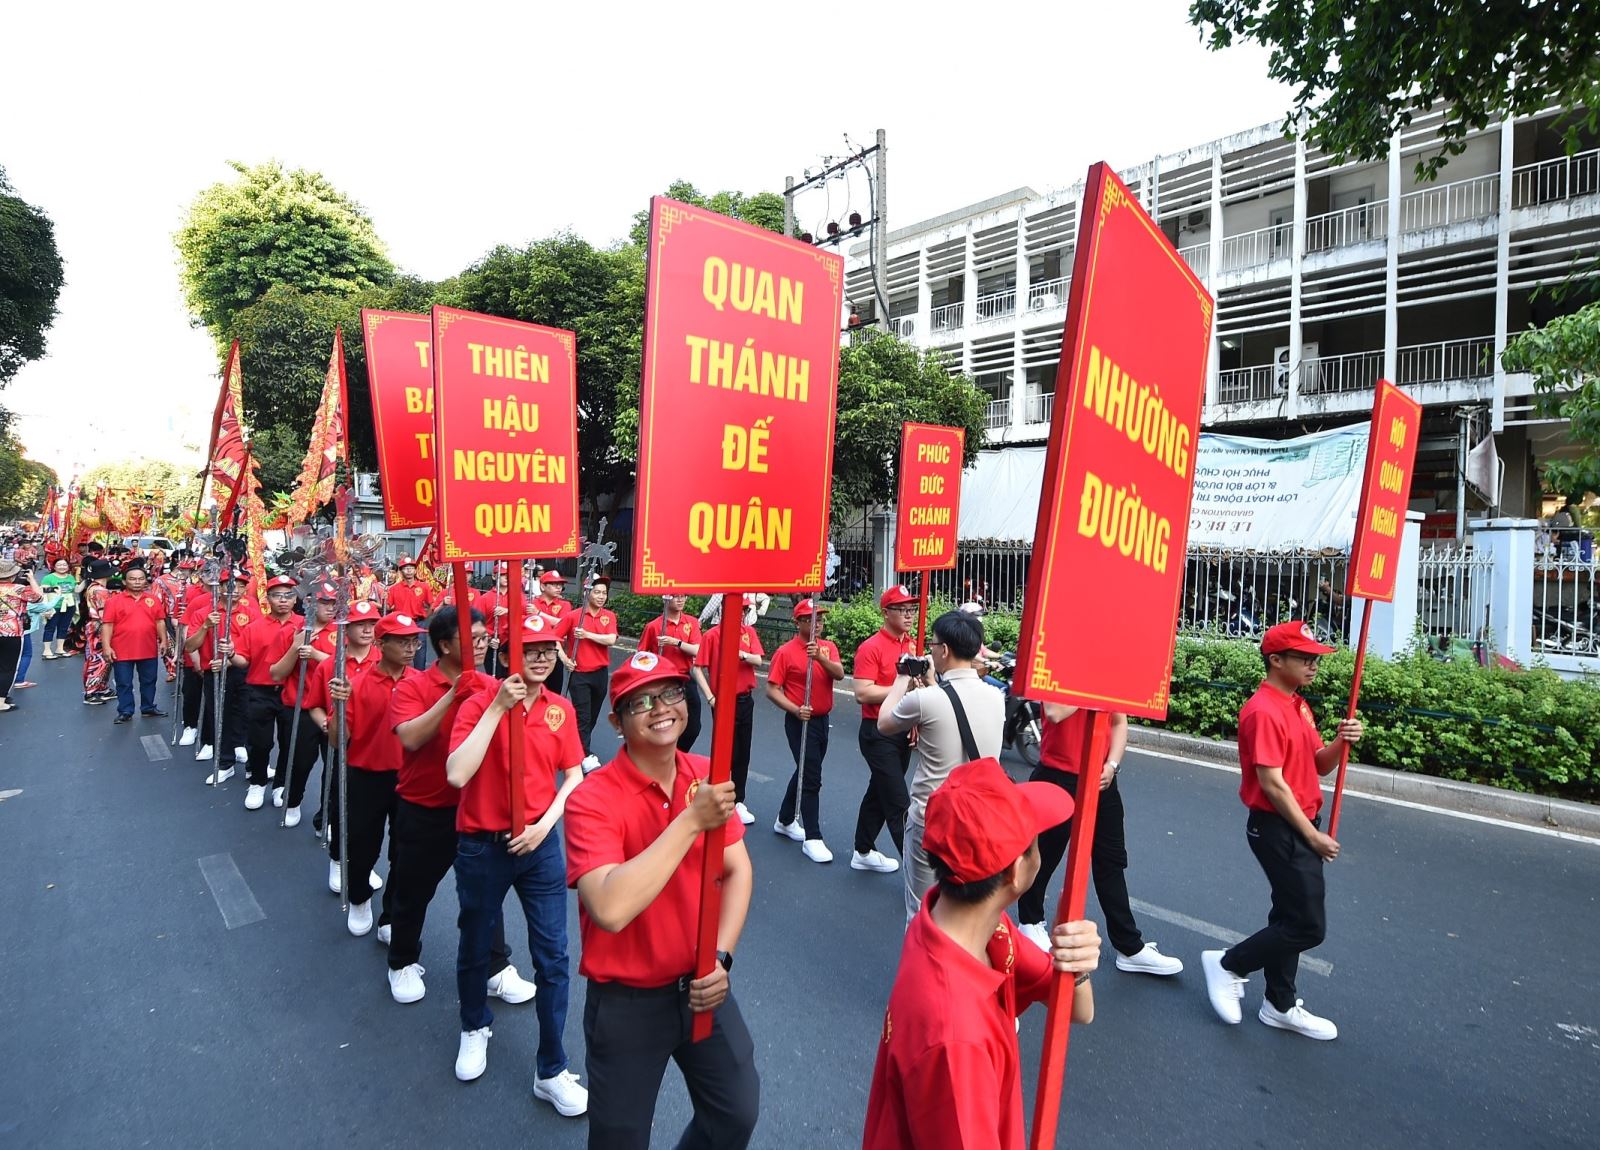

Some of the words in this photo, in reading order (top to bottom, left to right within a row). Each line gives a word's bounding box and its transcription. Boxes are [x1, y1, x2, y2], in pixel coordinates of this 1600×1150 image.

[702, 256, 804, 325] QUAN
[467, 343, 550, 384] THIÊN
[685, 335, 811, 403] THÁNH
[483, 394, 539, 438] HẬU
[1083, 344, 1190, 479] NHƯỜNG
[721, 415, 775, 474] ĐẾ
[1389, 416, 1407, 453] HỘI
[453, 448, 566, 484] NGUYÊN
[917, 441, 951, 465] PHÚC
[919, 472, 945, 495] ĐỨC
[1243, 467, 1271, 477] PHỤC
[1245, 482, 1266, 492] LỚP
[1268, 481, 1277, 490] &
[1379, 460, 1405, 496] QUÁN
[909, 503, 951, 526] CHÁNH
[1201, 508, 1254, 517] GRADUATION
[1213, 493, 1243, 504] ĐỘNG
[1245, 493, 1275, 503] HOẠT
[1277, 493, 1298, 503] LỚP
[475, 498, 551, 538] QUÂN
[688, 496, 792, 554] QUÂN
[1077, 470, 1171, 574] ĐƯỜNG
[1369, 552, 1386, 580] AN
